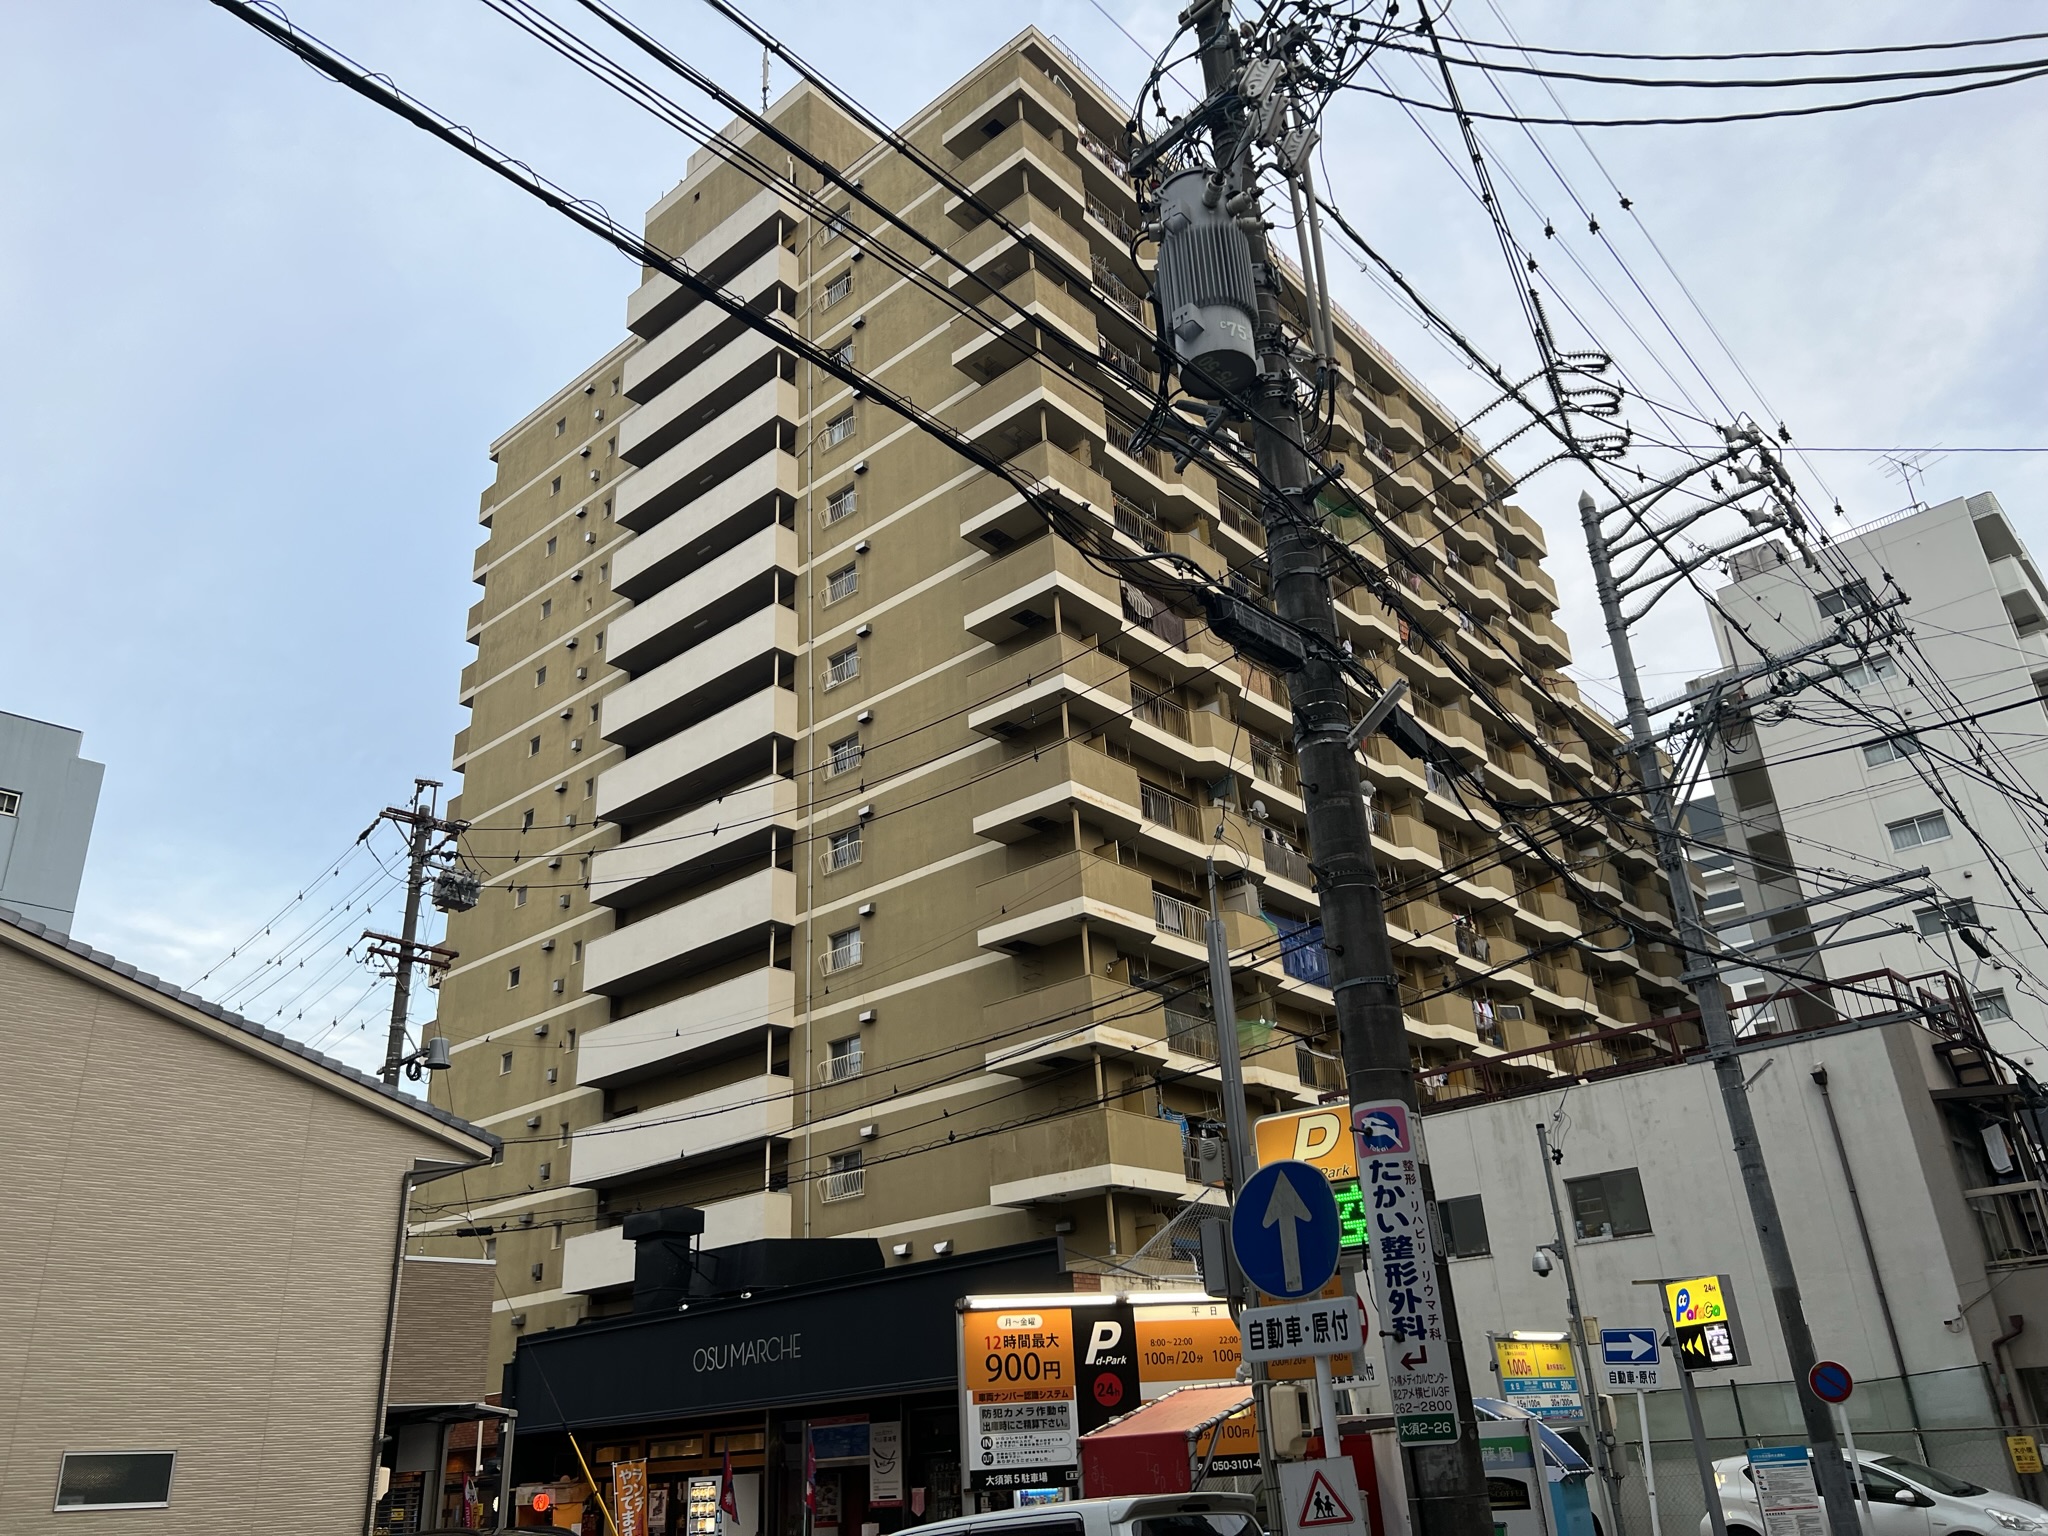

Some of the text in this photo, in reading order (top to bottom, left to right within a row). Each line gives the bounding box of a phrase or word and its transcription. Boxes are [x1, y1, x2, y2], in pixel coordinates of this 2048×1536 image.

[1293, 1113, 1341, 1162] P
[1369, 1160, 1428, 1341] たかい整形外科
[984, 1332, 1060, 1351] 12時間最大
[1249, 1308, 1349, 1352] 自動車・原付
[693, 1333, 802, 1372] OSU MARCHE
[1084, 1320, 1122, 1366] P
[985, 1352, 1061, 1383] 900円
[1095, 1354, 1128, 1366] d-Park
[1609, 1370, 1657, 1385] 自動車・原付
[981, 1405, 1067, 1419] 防犯カメラ作動中
[1394, 1400, 1453, 1415] 262-2800
[1400, 1421, 1452, 1436] 大須2-26
[632, 1467, 645, 1512] ランチ
[985, 1472, 1048, 1486] 大須第5駐車場
